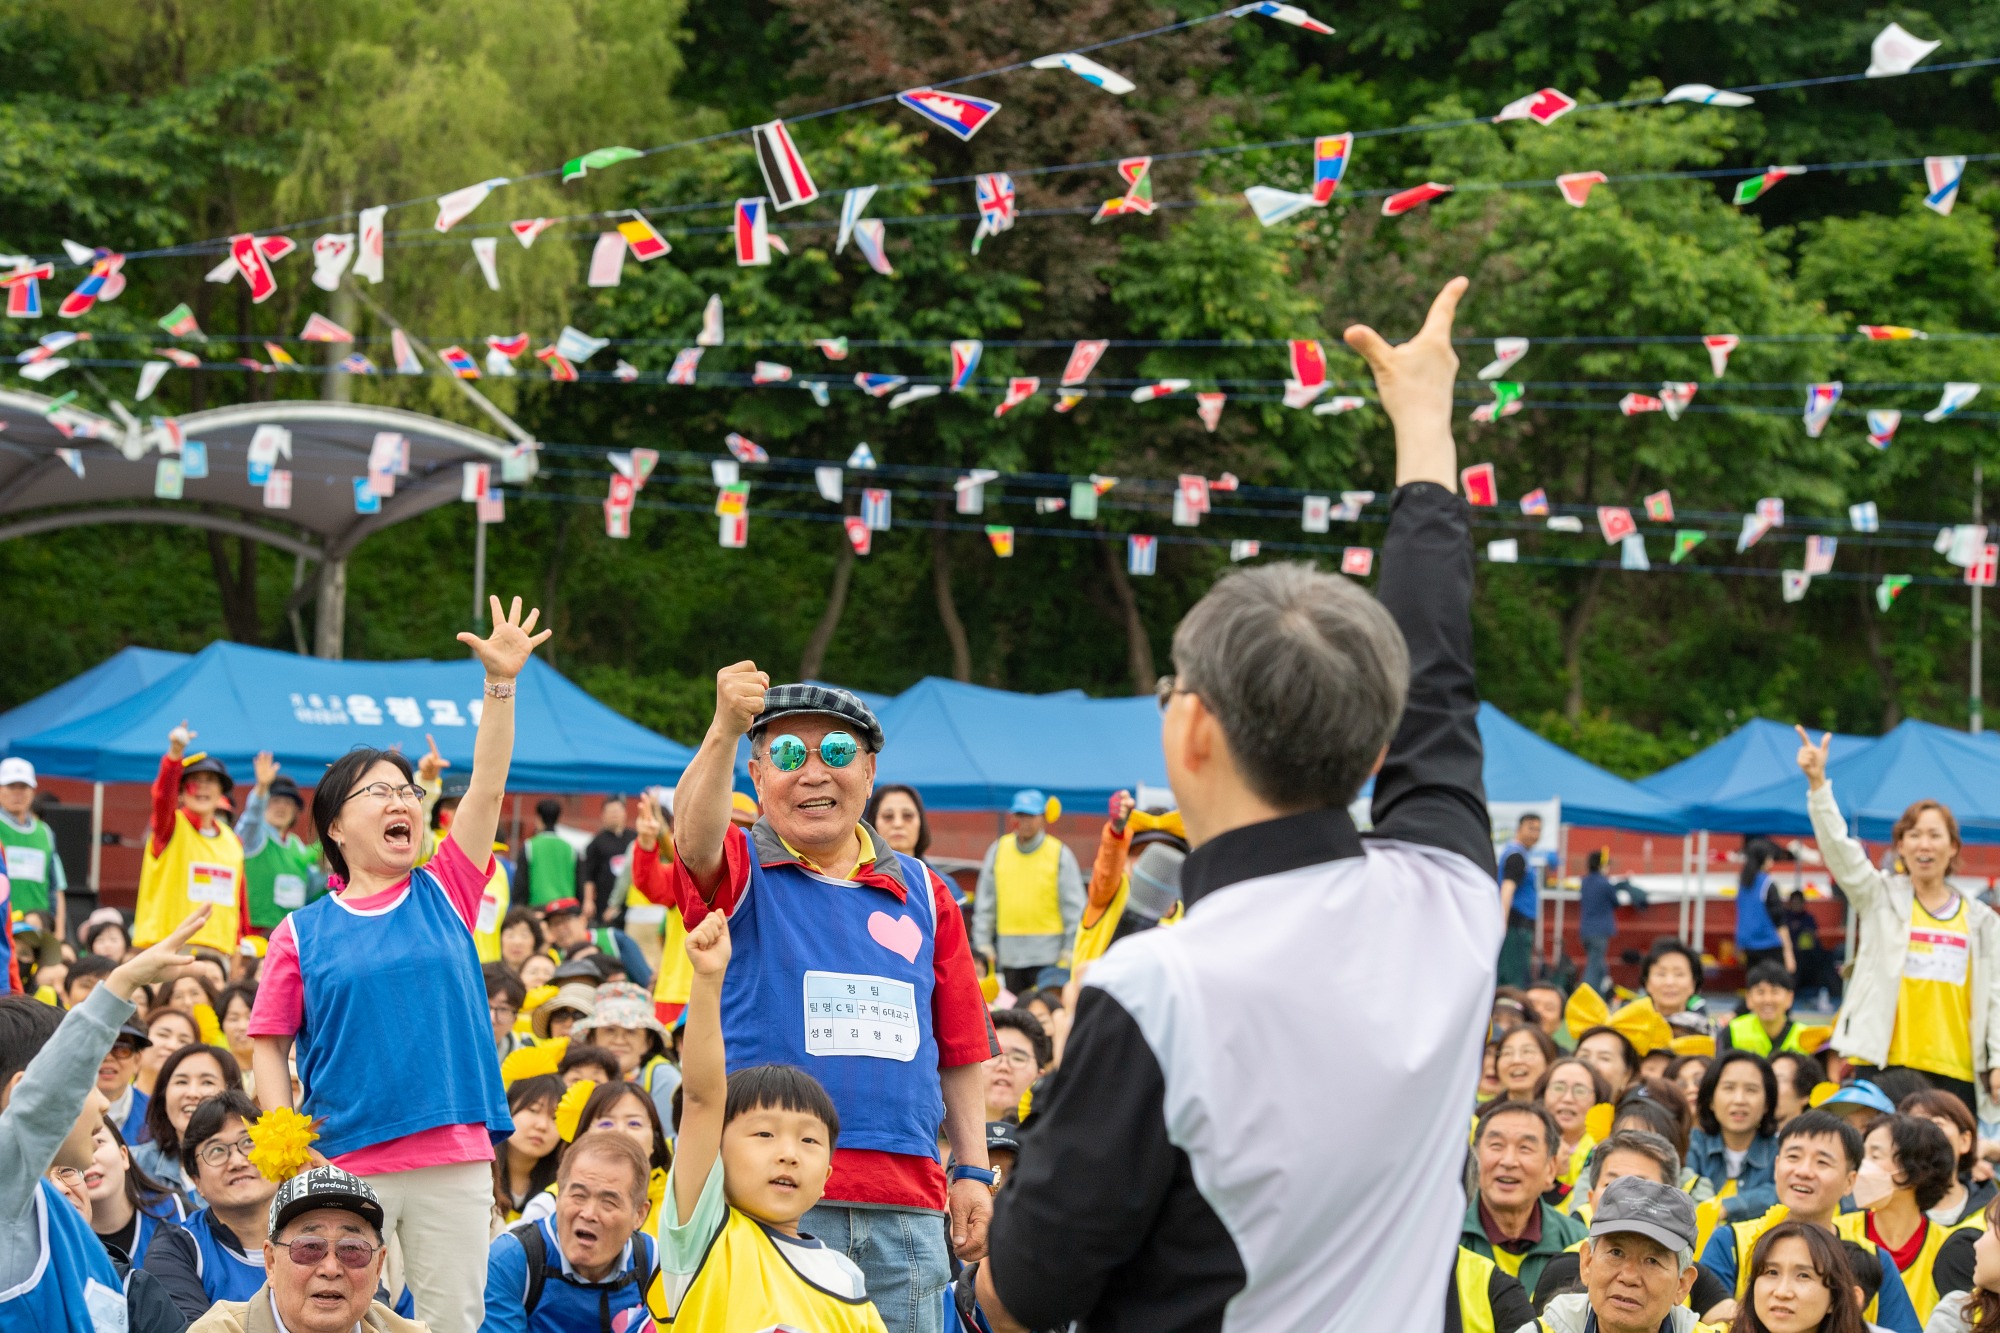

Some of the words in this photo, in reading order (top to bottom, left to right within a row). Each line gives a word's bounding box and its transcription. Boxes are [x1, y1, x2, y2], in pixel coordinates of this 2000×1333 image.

[870, 986, 879, 996] 팀
[810, 1002, 818, 1012] 팀
[822, 1002, 831, 1012] 명
[836, 1004, 842, 1012] C
[846, 1004, 854, 1013] 팀
[859, 1004, 867, 1014] 구
[871, 1005, 879, 1015] 역
[882, 1008, 910, 1021] 6대교구
[811, 1028, 819, 1038] 성
[823, 1028, 832, 1038] 명
[850, 1028, 859, 1038] 김
